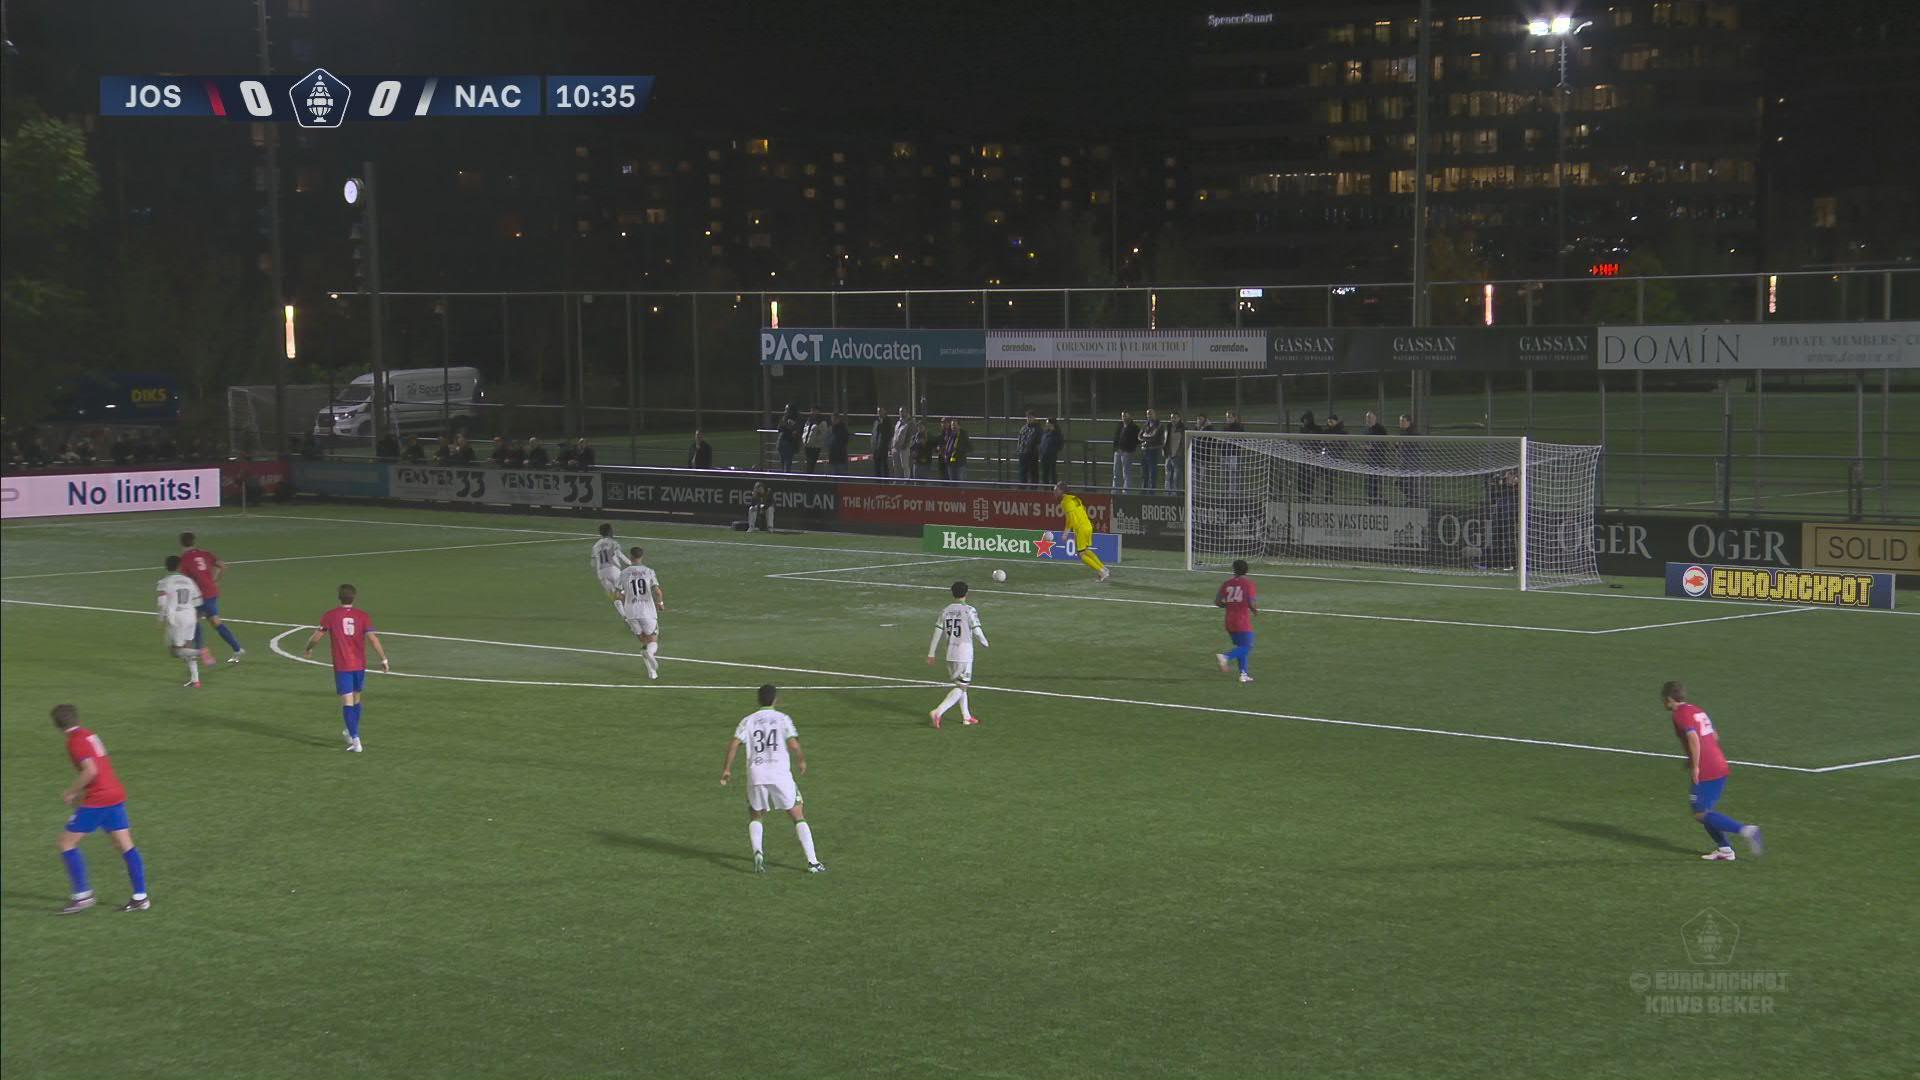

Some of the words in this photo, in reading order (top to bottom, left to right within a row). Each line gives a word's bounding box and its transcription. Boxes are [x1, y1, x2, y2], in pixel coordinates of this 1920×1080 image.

[761, 333, 824, 362] PACT
[830, 337, 922, 361] Advocaten
[1274, 336, 1335, 352] GASSAN
[1393, 336, 1457, 352] GASSAN
[1519, 335, 1588, 352] GASSAN
[1604, 328, 1741, 364] DOMÍN
[1772, 335, 1825, 347] PRIVATE
[68, 481, 107, 505] No
[117, 476, 201, 504] limits!
[627, 485, 655, 501] HET
[661, 486, 723, 504] ZWARTE
[729, 489, 834, 510] FIEENPLAN
[842, 496, 861, 508] THE
[903, 499, 924, 512] POT
[925, 500, 935, 512] IN
[936, 501, 967, 513] TOWN
[993, 501, 1041, 518] YUAN'S
[1045, 502, 1106, 520] HOOT
[1142, 504, 1177, 522] BROERS
[942, 531, 1031, 554] Heineken
[1828, 536, 1908, 561] SOLID
[630, 578, 647, 596] 19
[1226, 586, 1243, 603] 24
[1712, 567, 1873, 606] EUROJACKPOT
[342, 617, 355, 636] 6
[945, 618, 962, 638] 55
[753, 729, 778, 753] 34
